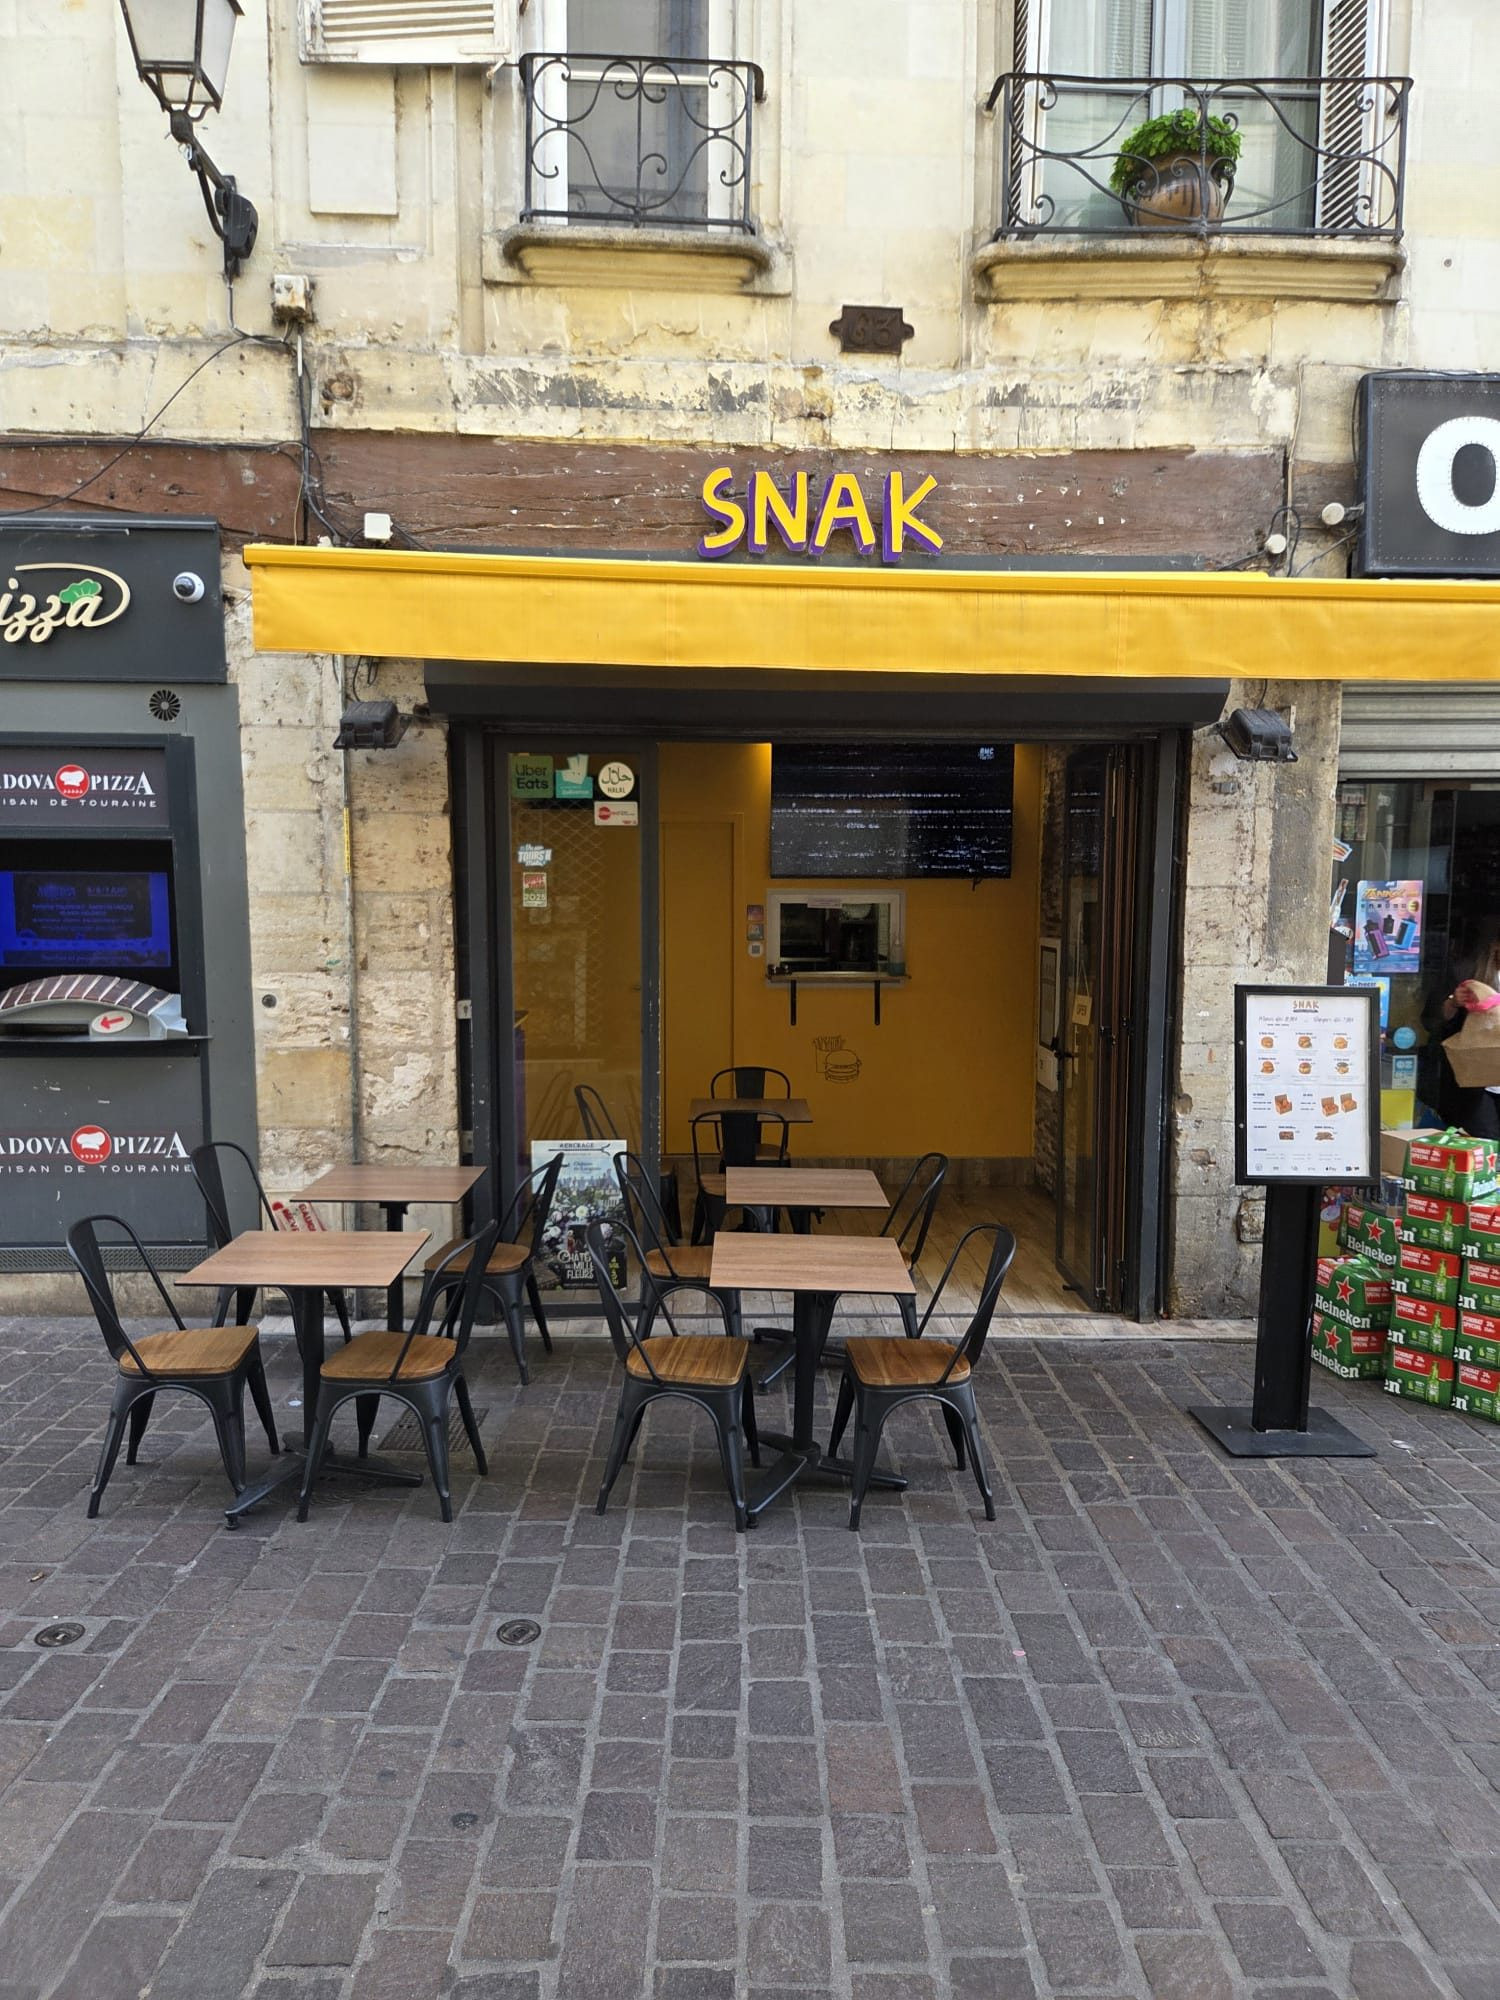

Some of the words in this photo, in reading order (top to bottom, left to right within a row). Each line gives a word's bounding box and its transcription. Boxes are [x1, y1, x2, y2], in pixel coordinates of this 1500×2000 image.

[697, 466, 944, 562] SNAK
[516, 764, 547, 777] Uber
[602, 767, 632, 785] حلال
[0, 774, 55, 790] DOVA
[91, 771, 155, 795] PIZZA
[517, 777, 549, 790] Eats
[80, 799, 157, 808] TOURAINE
[1293, 1000, 1319, 1009] SNAK
[114, 1131, 190, 1158] PIZZA
[65, 1165, 86, 1173] DE
[100, 1165, 192, 1173] TOURAINE
[1315, 1293, 1370, 1328] Heineken
